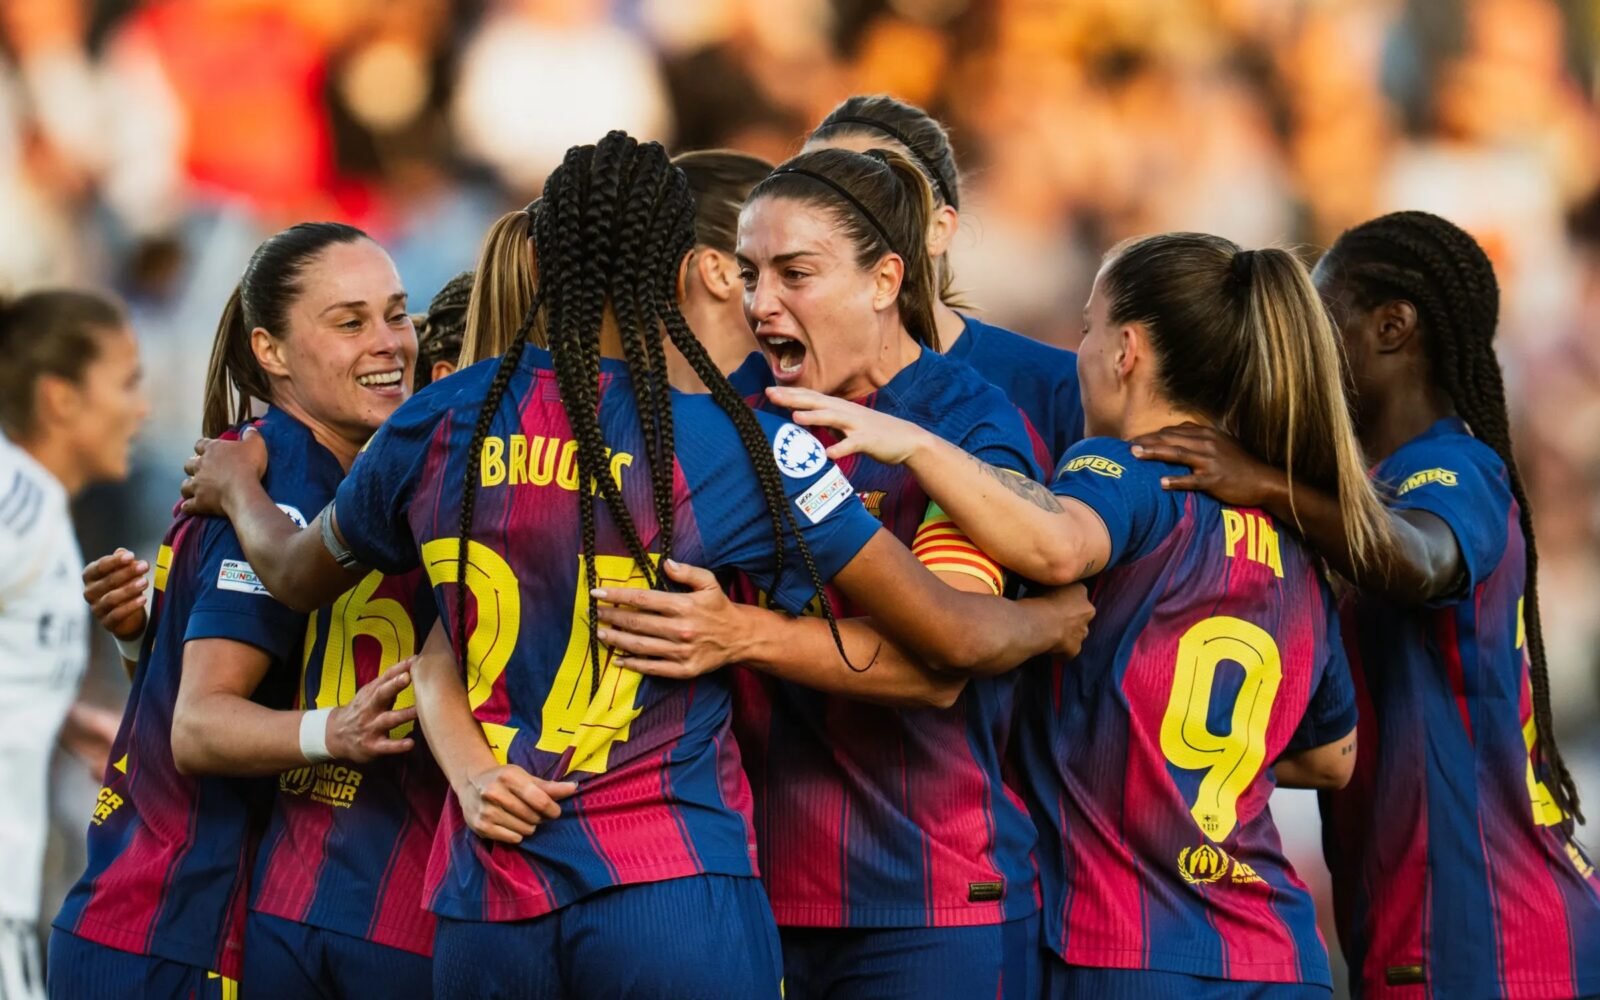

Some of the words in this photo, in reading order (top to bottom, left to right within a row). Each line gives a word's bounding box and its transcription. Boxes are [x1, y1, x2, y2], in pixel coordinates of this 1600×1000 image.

[481, 434, 633, 499] BRUG
[1063, 456, 1124, 477] IMBO
[1398, 469, 1458, 496] IMBO
[421, 537, 661, 777] 24
[1160, 616, 1283, 843] 9
